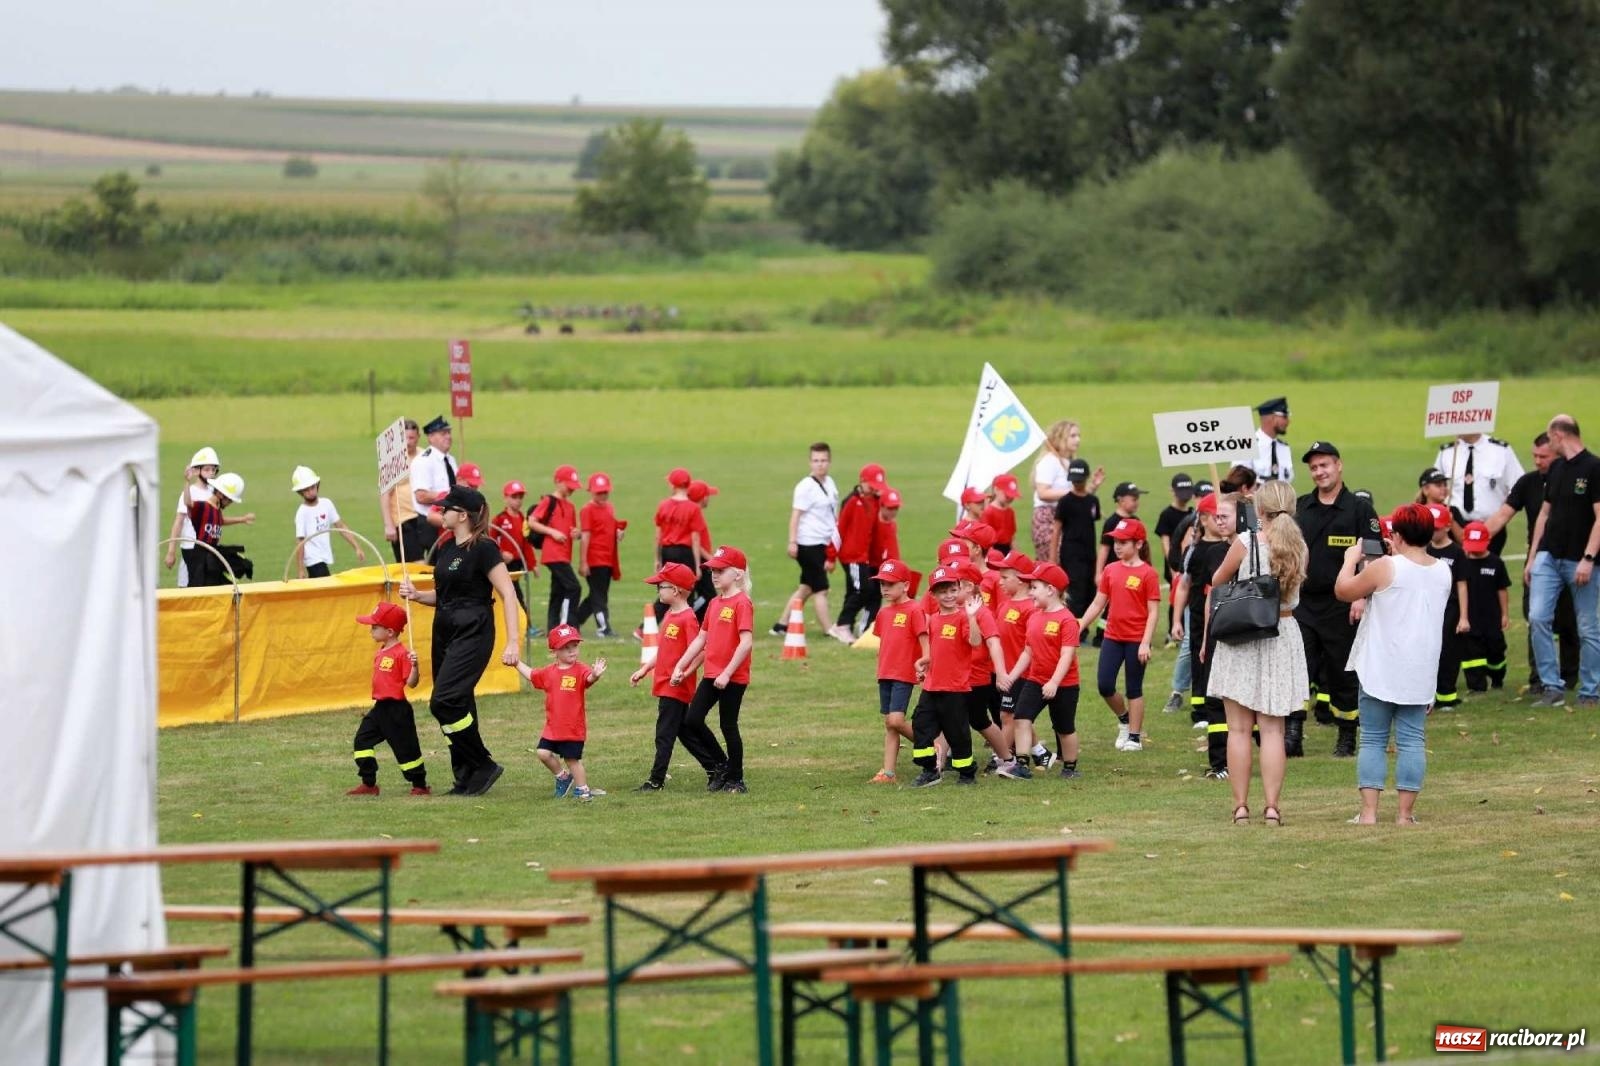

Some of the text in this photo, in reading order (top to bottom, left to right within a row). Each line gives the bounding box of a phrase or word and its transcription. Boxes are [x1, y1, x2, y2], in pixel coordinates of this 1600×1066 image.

[1452, 389, 1473, 404] OSP
[1428, 408, 1493, 426] PIETRASZYN
[1186, 420, 1220, 433] OSP
[1168, 435, 1252, 455] ROSZKÓW
